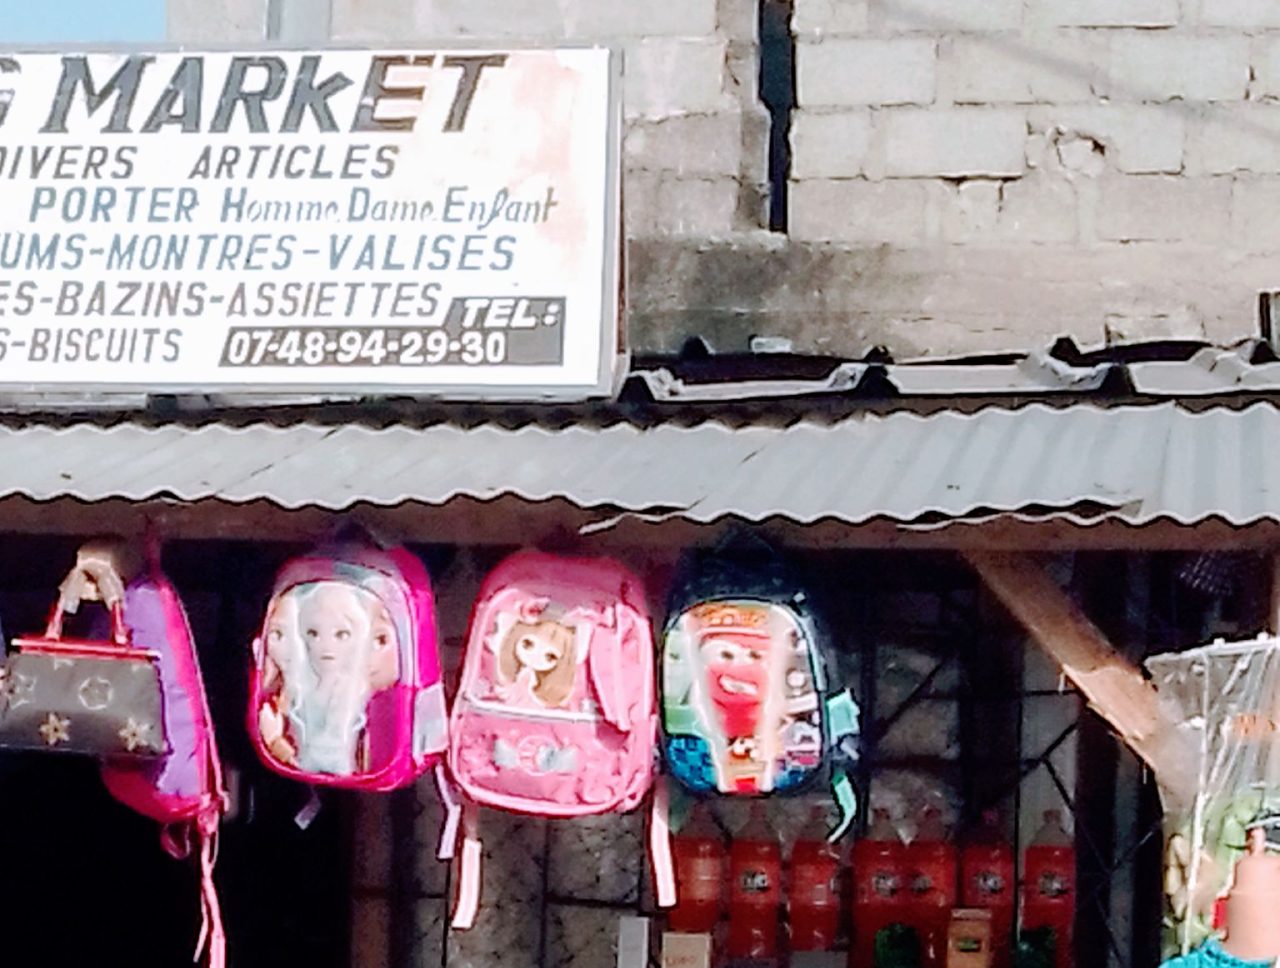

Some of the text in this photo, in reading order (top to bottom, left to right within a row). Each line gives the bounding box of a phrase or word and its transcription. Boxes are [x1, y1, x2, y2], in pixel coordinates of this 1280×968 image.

[187, 144, 400, 180] ARTICLES
[29, 187, 200, 223] PORTER
[442, 186, 558, 230] Enfant
